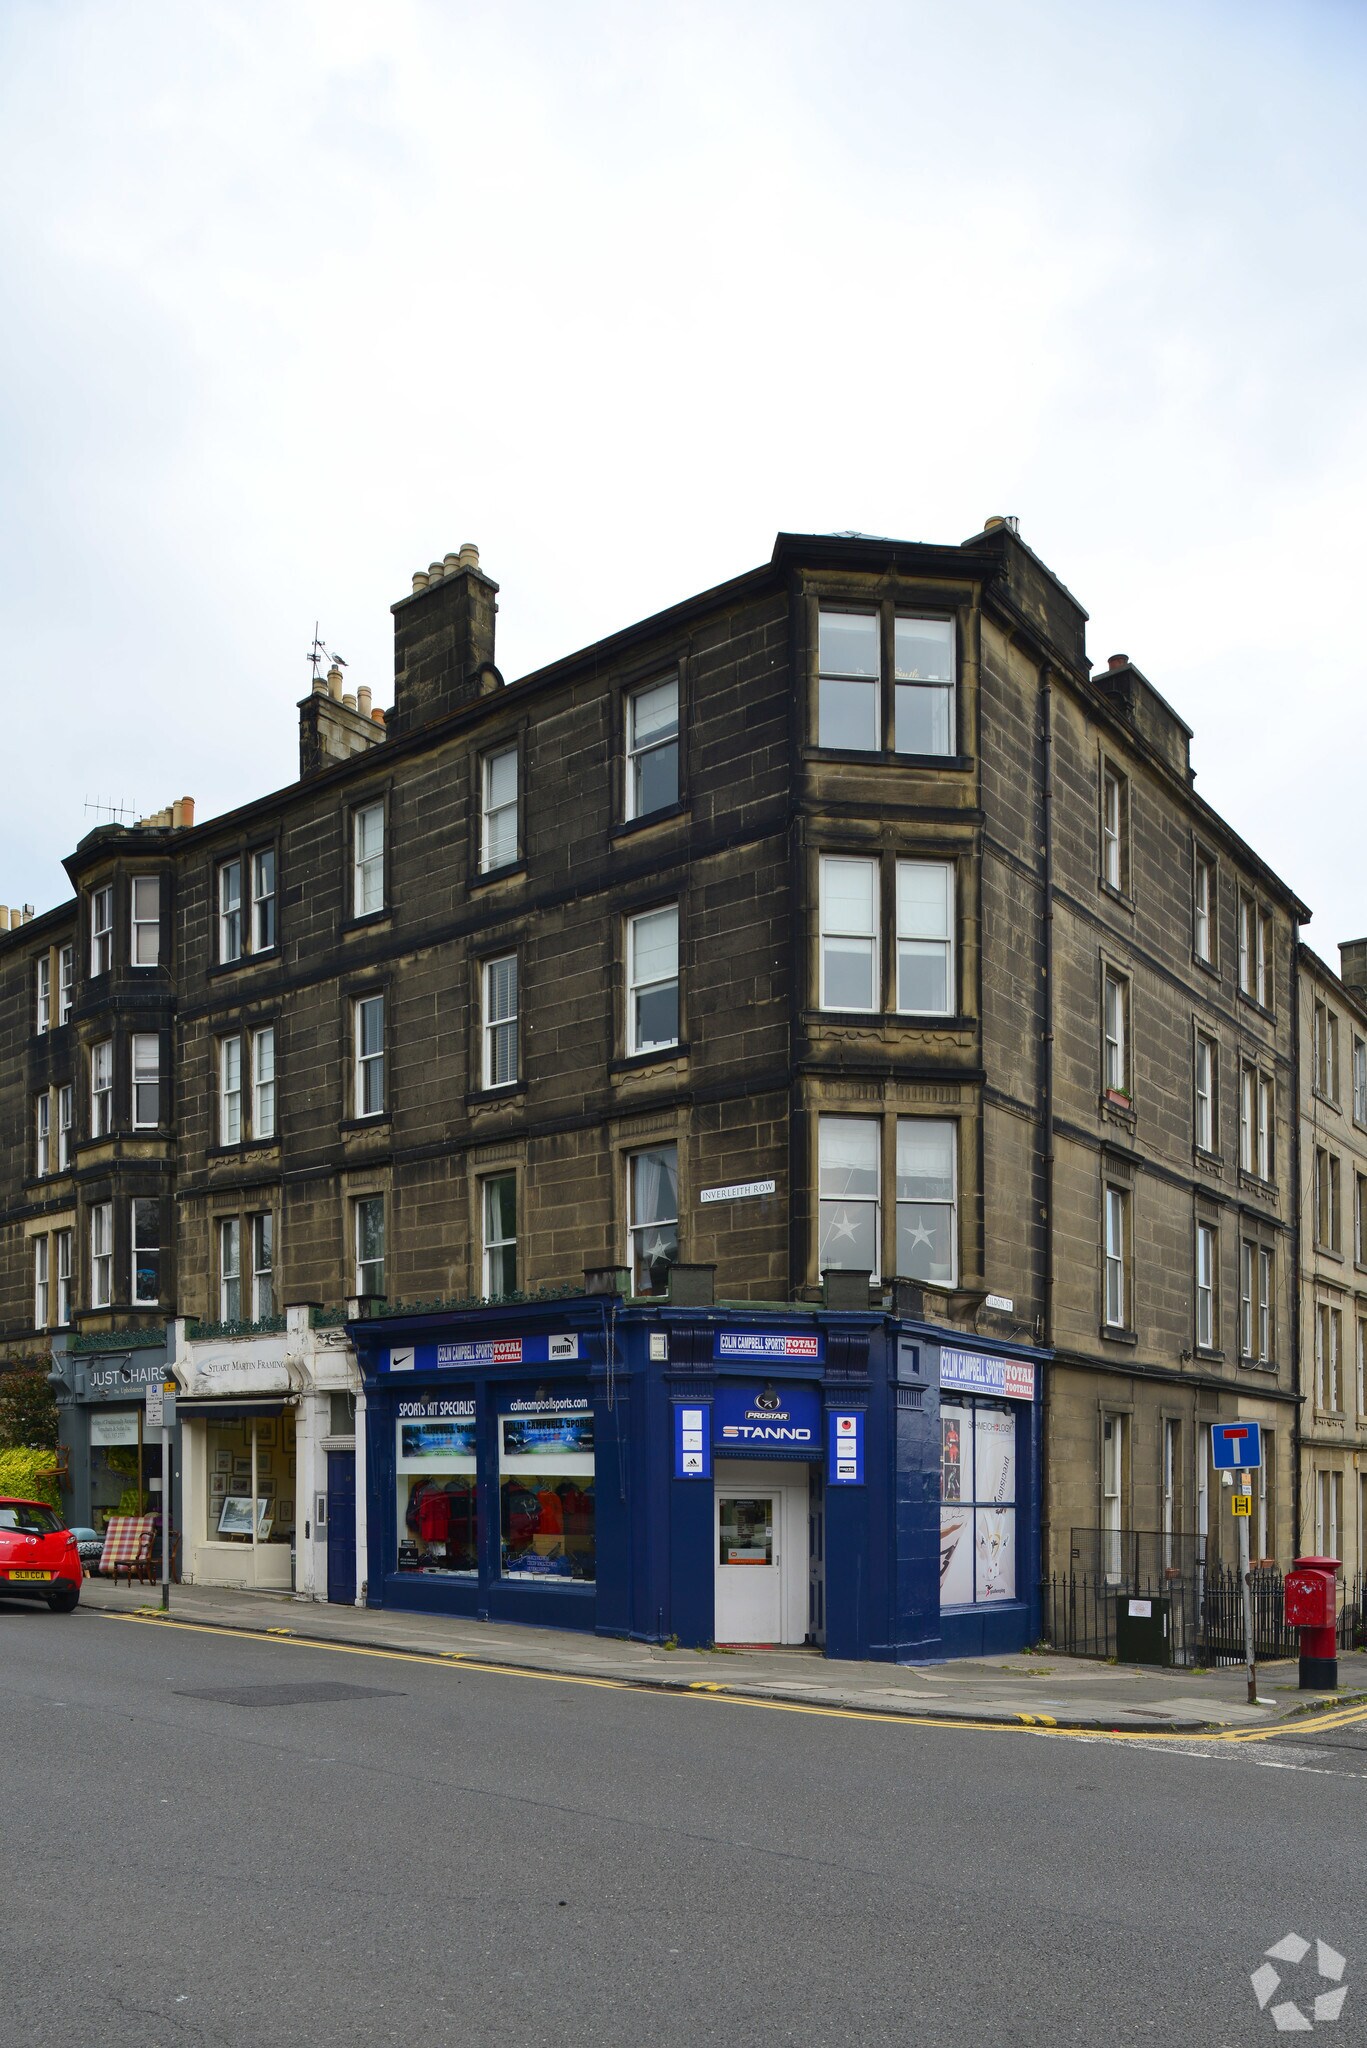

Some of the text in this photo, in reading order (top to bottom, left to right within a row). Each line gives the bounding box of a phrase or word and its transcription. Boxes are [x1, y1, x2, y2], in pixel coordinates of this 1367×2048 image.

[702, 1183, 773, 1200] INVERLEITH ROW
[986, 1296, 1012, 1310] EILDON ST
[493, 1341, 521, 1353] TOTAL
[552, 1344, 571, 1354] PUMA
[721, 1335, 785, 1351] COLIN CAMPBELL SPORTS
[786, 1339, 817, 1348] TOTAL
[439, 1343, 493, 1362] COLIN CAMPBELL SPORTS
[493, 1353, 521, 1361] FOOTBALL
[208, 1360, 286, 1373] STUART MARTIN FRAMING
[941, 1350, 1005, 1386] COLIN CAMPBELL SPORTS
[1005, 1364, 1033, 1383] TOTAL
[90, 1367, 168, 1386] JUST CHAIRS
[1005, 1383, 1033, 1394] FOOTBALL
[399, 1402, 426, 1417] SPORTS
[427, 1401, 439, 1416] KIT
[510, 1397, 588, 1413] colincampbellsports.com
[747, 1412, 788, 1420] PROSTAR
[722, 1425, 811, 1440] STANNO
[997, 1455, 1010, 1502] precision
[30, 1571, 45, 1579] CCA
